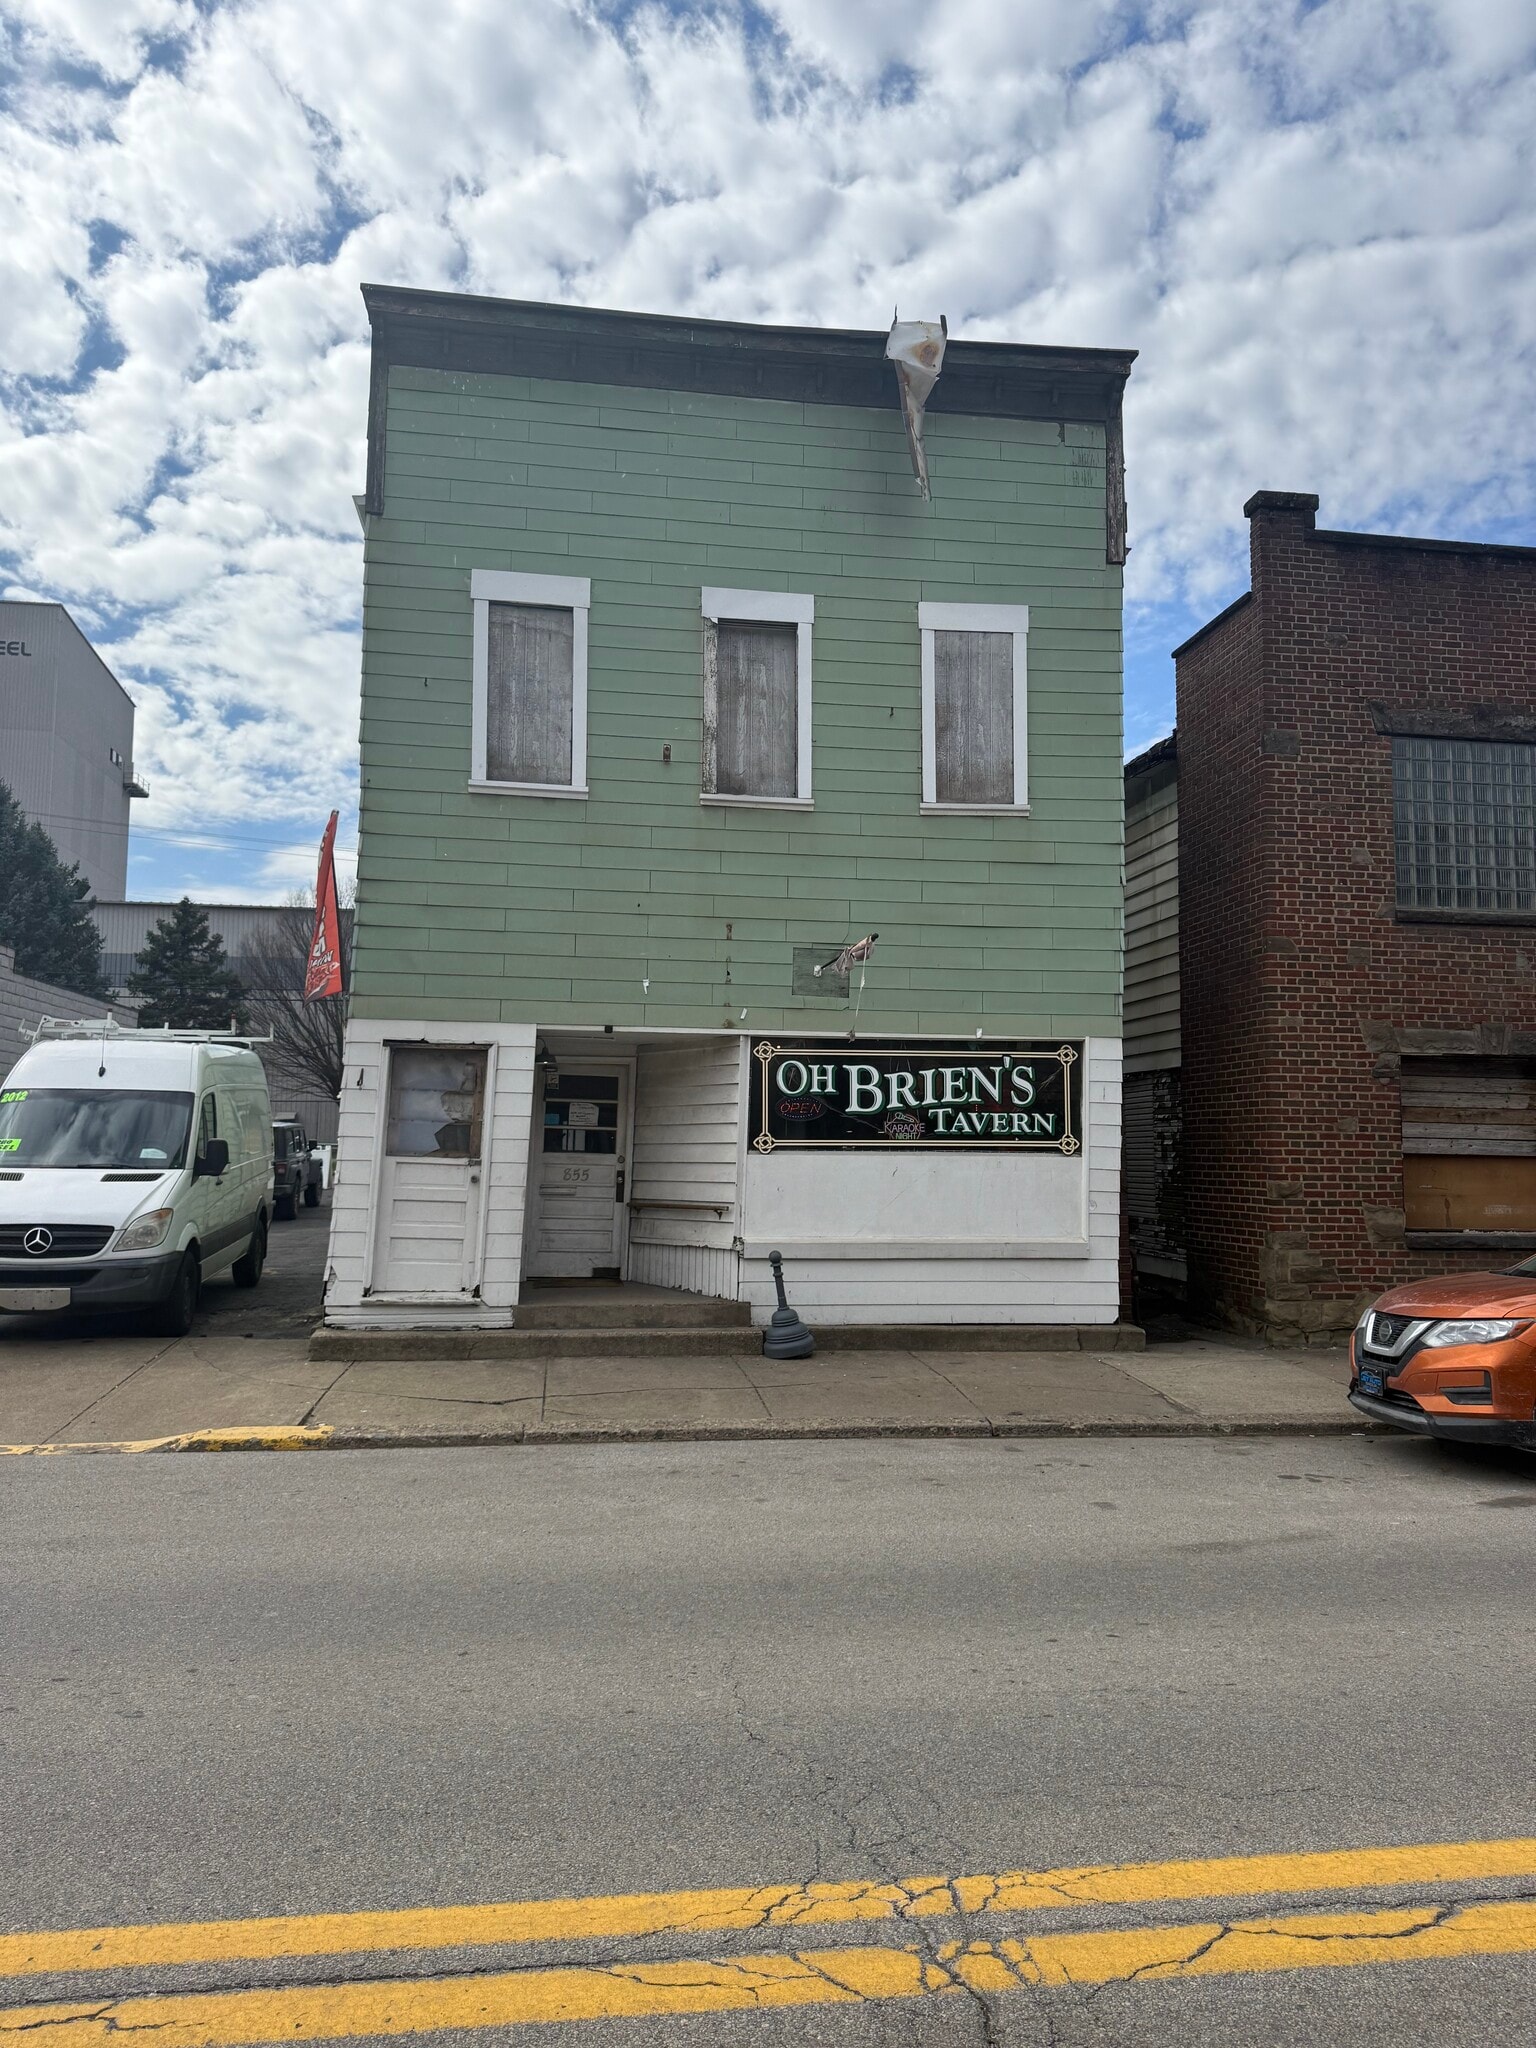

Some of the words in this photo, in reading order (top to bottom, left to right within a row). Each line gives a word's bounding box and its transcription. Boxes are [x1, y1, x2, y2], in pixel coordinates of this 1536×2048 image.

[776, 1060, 838, 1095] OH
[842, 1056, 1035, 1114] BRIEN'S
[1, 1091, 28, 1103] 2012
[780, 1102, 821, 1114] OPEN
[884, 1121, 926, 1133] KARAOKE
[928, 1108, 1056, 1134] TAVERN
[563, 1168, 590, 1181] 855
